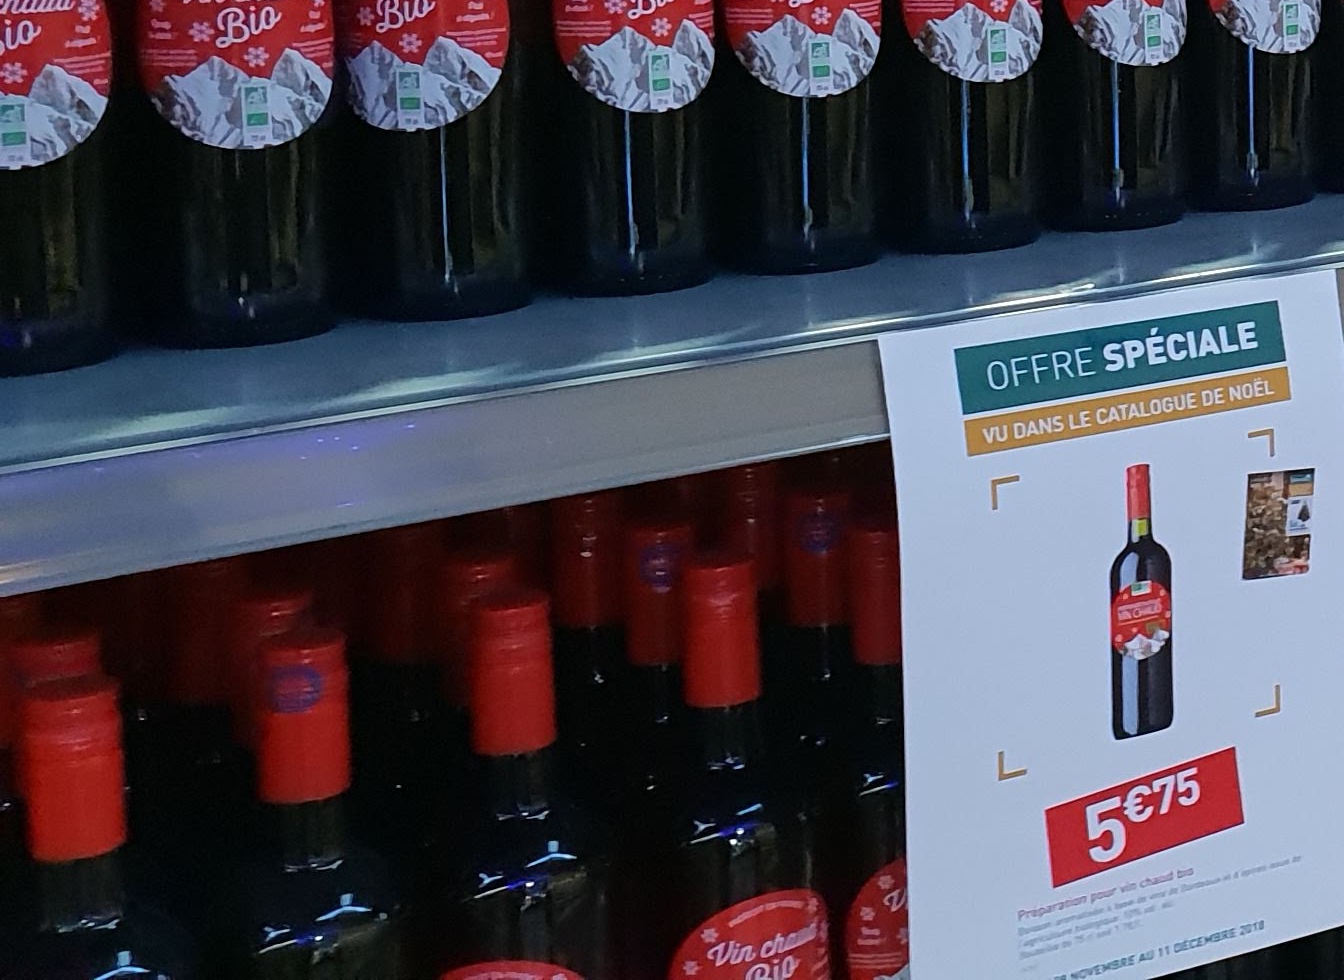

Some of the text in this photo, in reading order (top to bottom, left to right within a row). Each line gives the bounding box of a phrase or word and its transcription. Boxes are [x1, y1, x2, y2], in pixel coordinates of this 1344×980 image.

[215, 6, 282, 49] Bio
[986, 322, 1259, 391] OFFRE SPÉCIALE
[982, 376, 1275, 445] VU DANS LE CATALOGUE DE NOËL
[1084, 766, 1202, 864] 5€75
[1091, 888, 1117, 904] pour
[1120, 882, 1136, 893] vin
[1140, 871, 1174, 888] chaud
[1177, 868, 1194, 878] bio
[707, 941, 756, 967] Vin
[1070, 955, 1135, 980] NOVEMBRE
[1139, 951, 1155, 962] AU
[1159, 947, 1170, 957] 11
[1174, 928, 1236, 953] DÉCEMBRE
[1240, 920, 1265, 936] 2018
